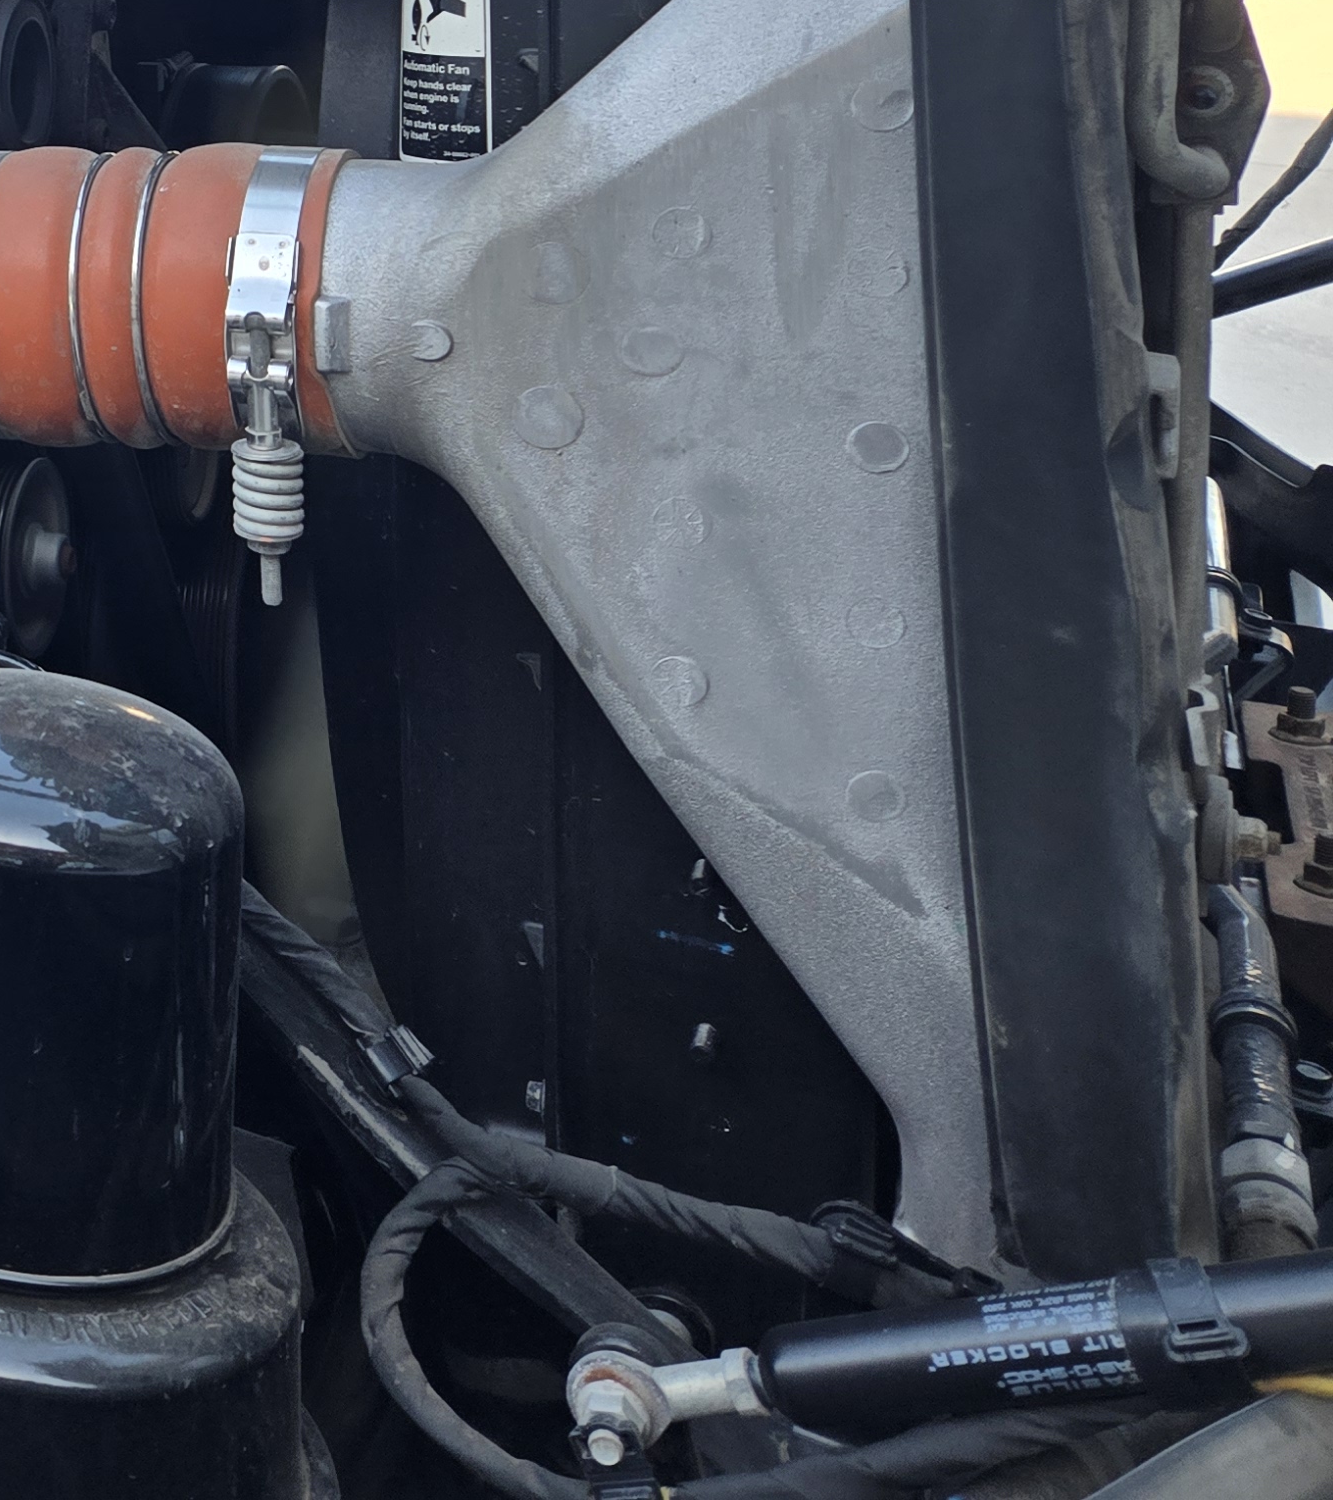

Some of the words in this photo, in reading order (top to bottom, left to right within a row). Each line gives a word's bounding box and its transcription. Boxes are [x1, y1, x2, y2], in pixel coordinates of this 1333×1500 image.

[404, 59, 445, 73] Automatic
[447, 63, 470, 75] Fan
[404, 77, 418, 89] Keep
[419, 79, 444, 91] hands
[446, 82, 472, 92] clear
[404, 90, 418, 99] when
[419, 92, 448, 103] engine
[450, 94, 460, 103] is
[403, 116, 413, 126] Fan
[414, 119, 436, 130] starts
[450, 122, 481, 135] stops
[1083, 1333, 1126, 1353] RIT
